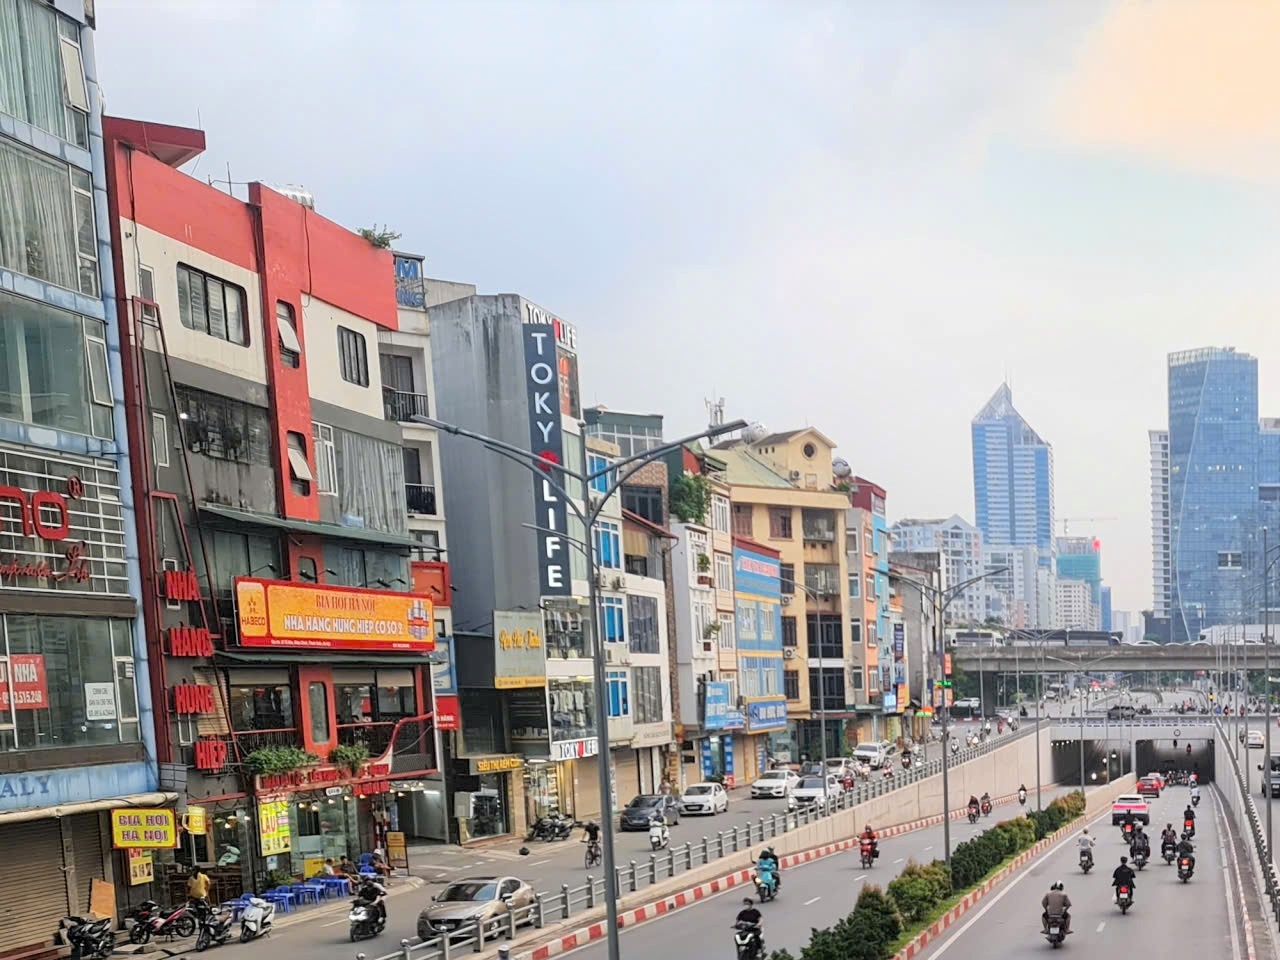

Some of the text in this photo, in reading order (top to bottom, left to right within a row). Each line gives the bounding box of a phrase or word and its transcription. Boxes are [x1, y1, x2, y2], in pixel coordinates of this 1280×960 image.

[241, 616, 266, 626] HABECO
[14, 660, 37, 682] NHÀ
[118, 815, 141, 826] BIA
